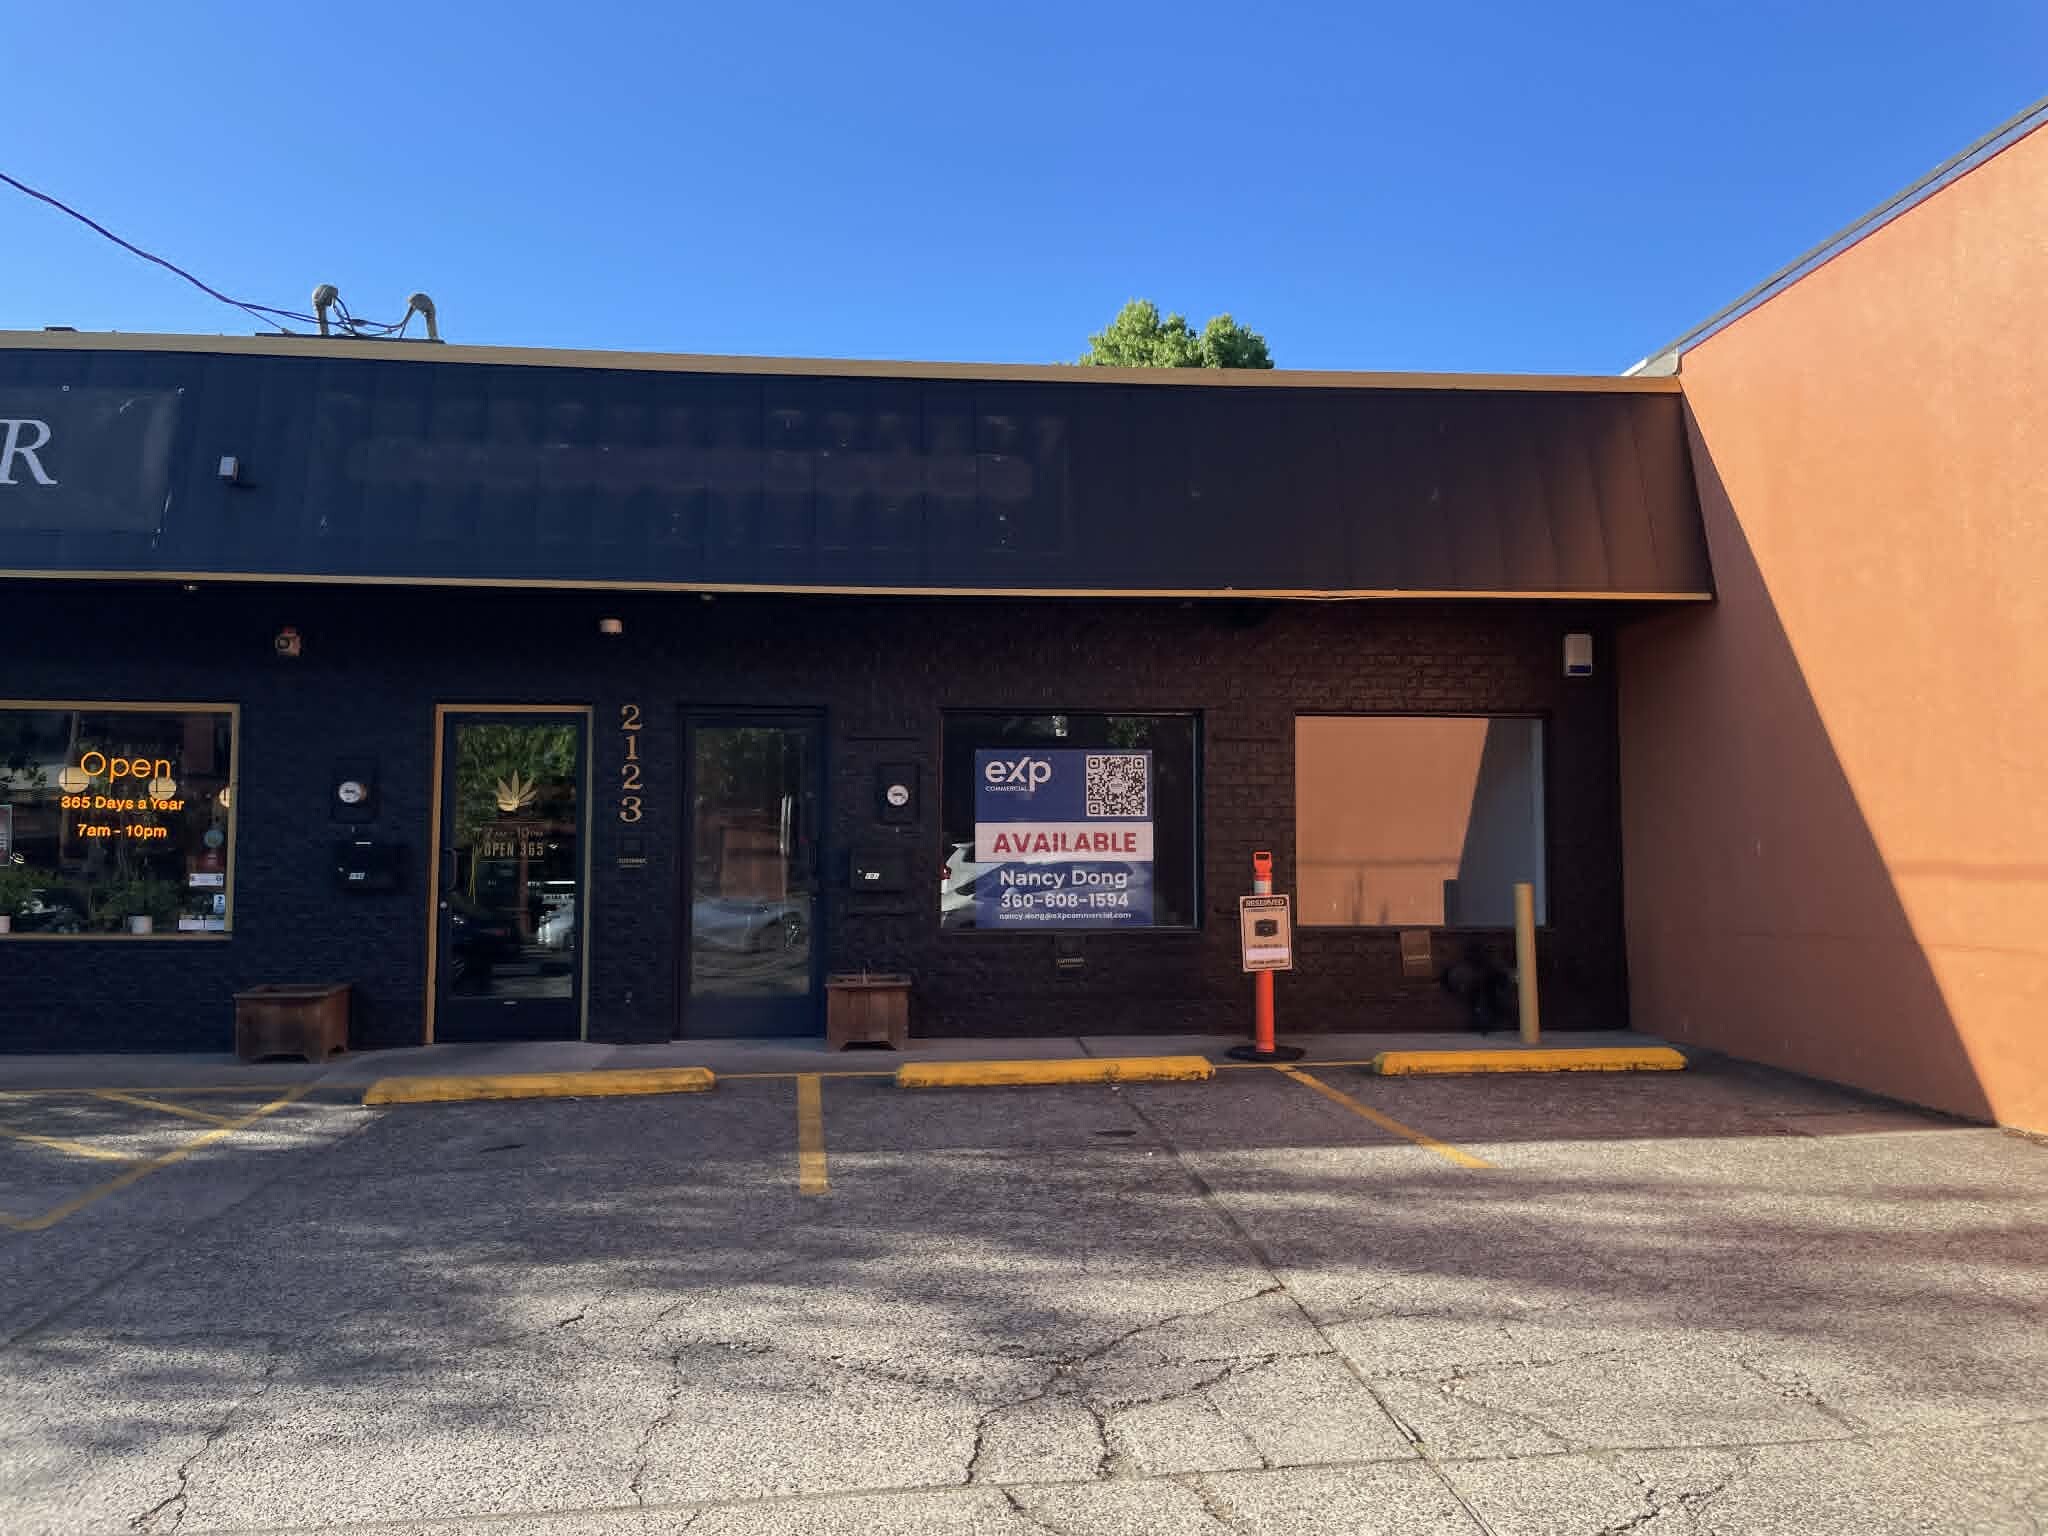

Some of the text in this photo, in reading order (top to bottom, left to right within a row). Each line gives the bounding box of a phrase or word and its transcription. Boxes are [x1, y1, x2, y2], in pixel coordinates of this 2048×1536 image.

[0, 419, 58, 485] R
[80, 751, 171, 784] Open
[619, 704, 643, 822] 2123
[61, 796, 185, 813] 365 Days a Year
[77, 823, 111, 837] 7am
[125, 824, 168, 840] 10pm
[484, 842, 544, 857] OPEN 365
[993, 832, 1137, 853] AVAILABLE
[1000, 869, 1128, 889] Nancy Dong
[1001, 893, 1129, 908] 360-608-1594
